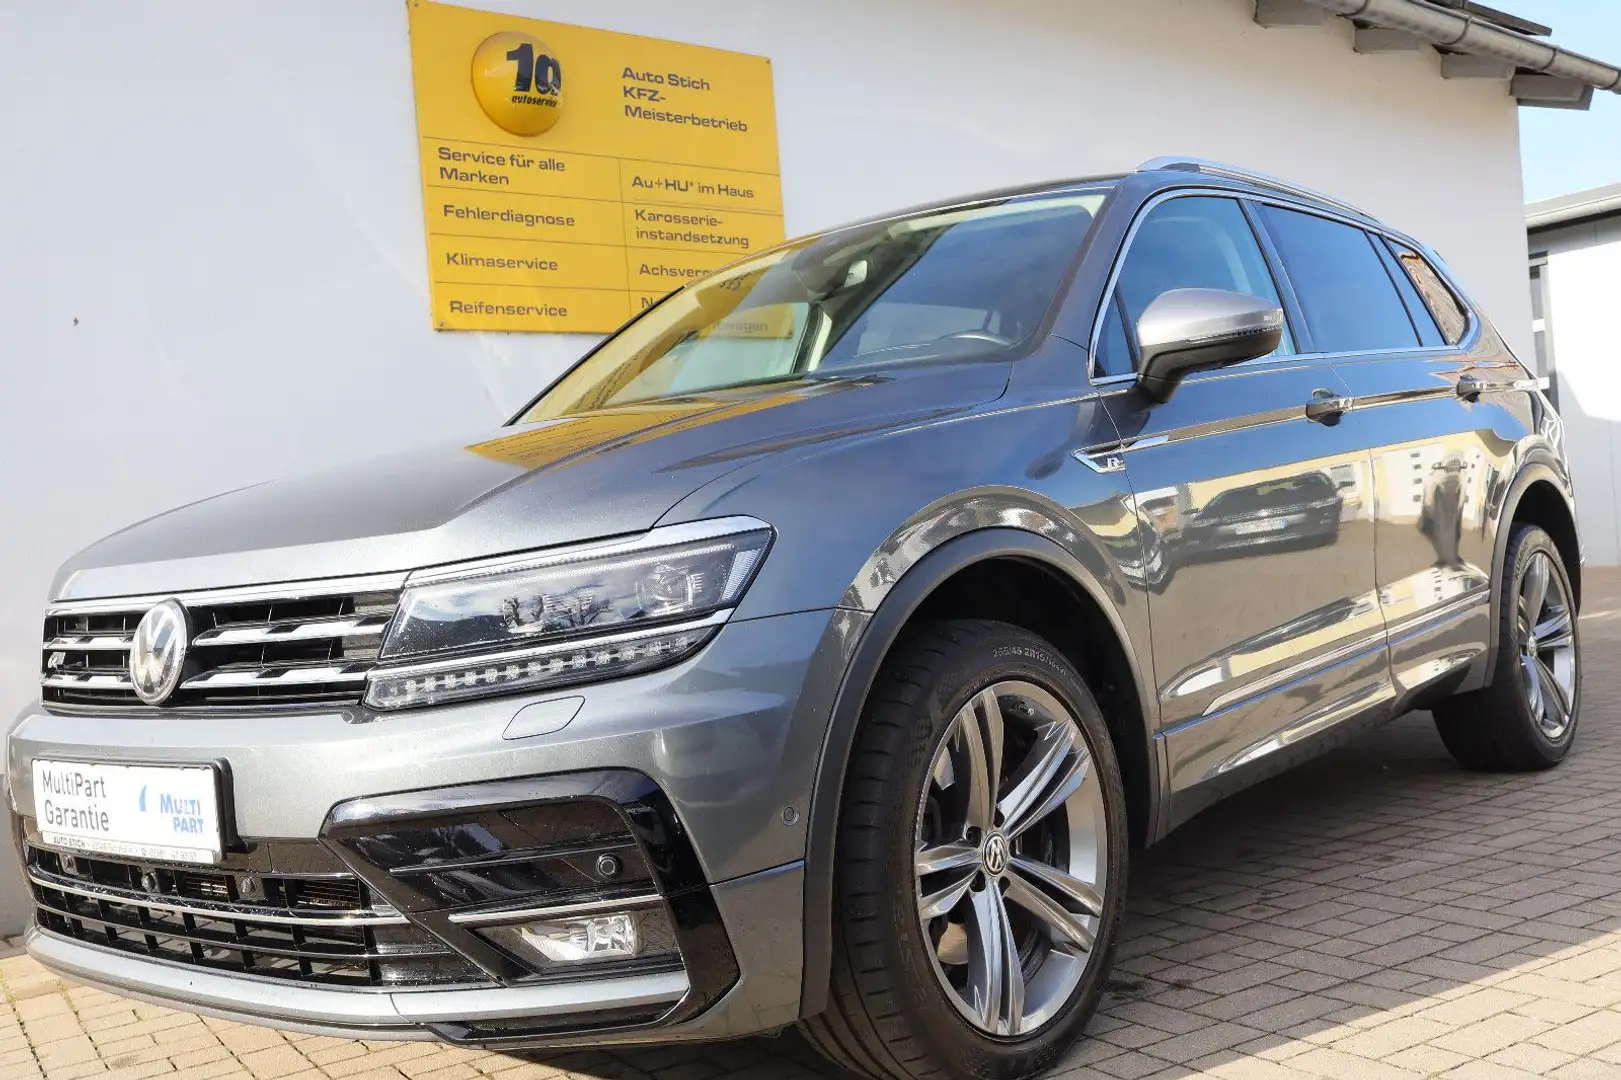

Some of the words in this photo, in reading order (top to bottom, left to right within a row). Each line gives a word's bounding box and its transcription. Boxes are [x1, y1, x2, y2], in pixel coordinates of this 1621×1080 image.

[622, 67, 664, 84] Auto
[667, 73, 710, 91] Stich
[623, 85, 666, 102] KFZ-
[624, 104, 748, 132] Meisterbetrieb
[438, 146, 506, 166] Service
[509, 154, 534, 168] für
[538, 158, 566, 172] alle
[440, 166, 509, 185] Marken
[698, 181, 715, 195] im
[718, 184, 754, 198] Haus
[443, 204, 575, 227] Fehlerdiagnose
[635, 209, 723, 227] Karosserie-
[636, 227, 749, 249] instandsetzung
[446, 252, 558, 271] Klimaservice
[450, 300, 568, 317] Reifenservice
[42, 769, 107, 798] MultiPart
[44, 799, 109, 832] Garantie
[172, 816, 204, 834] PART
